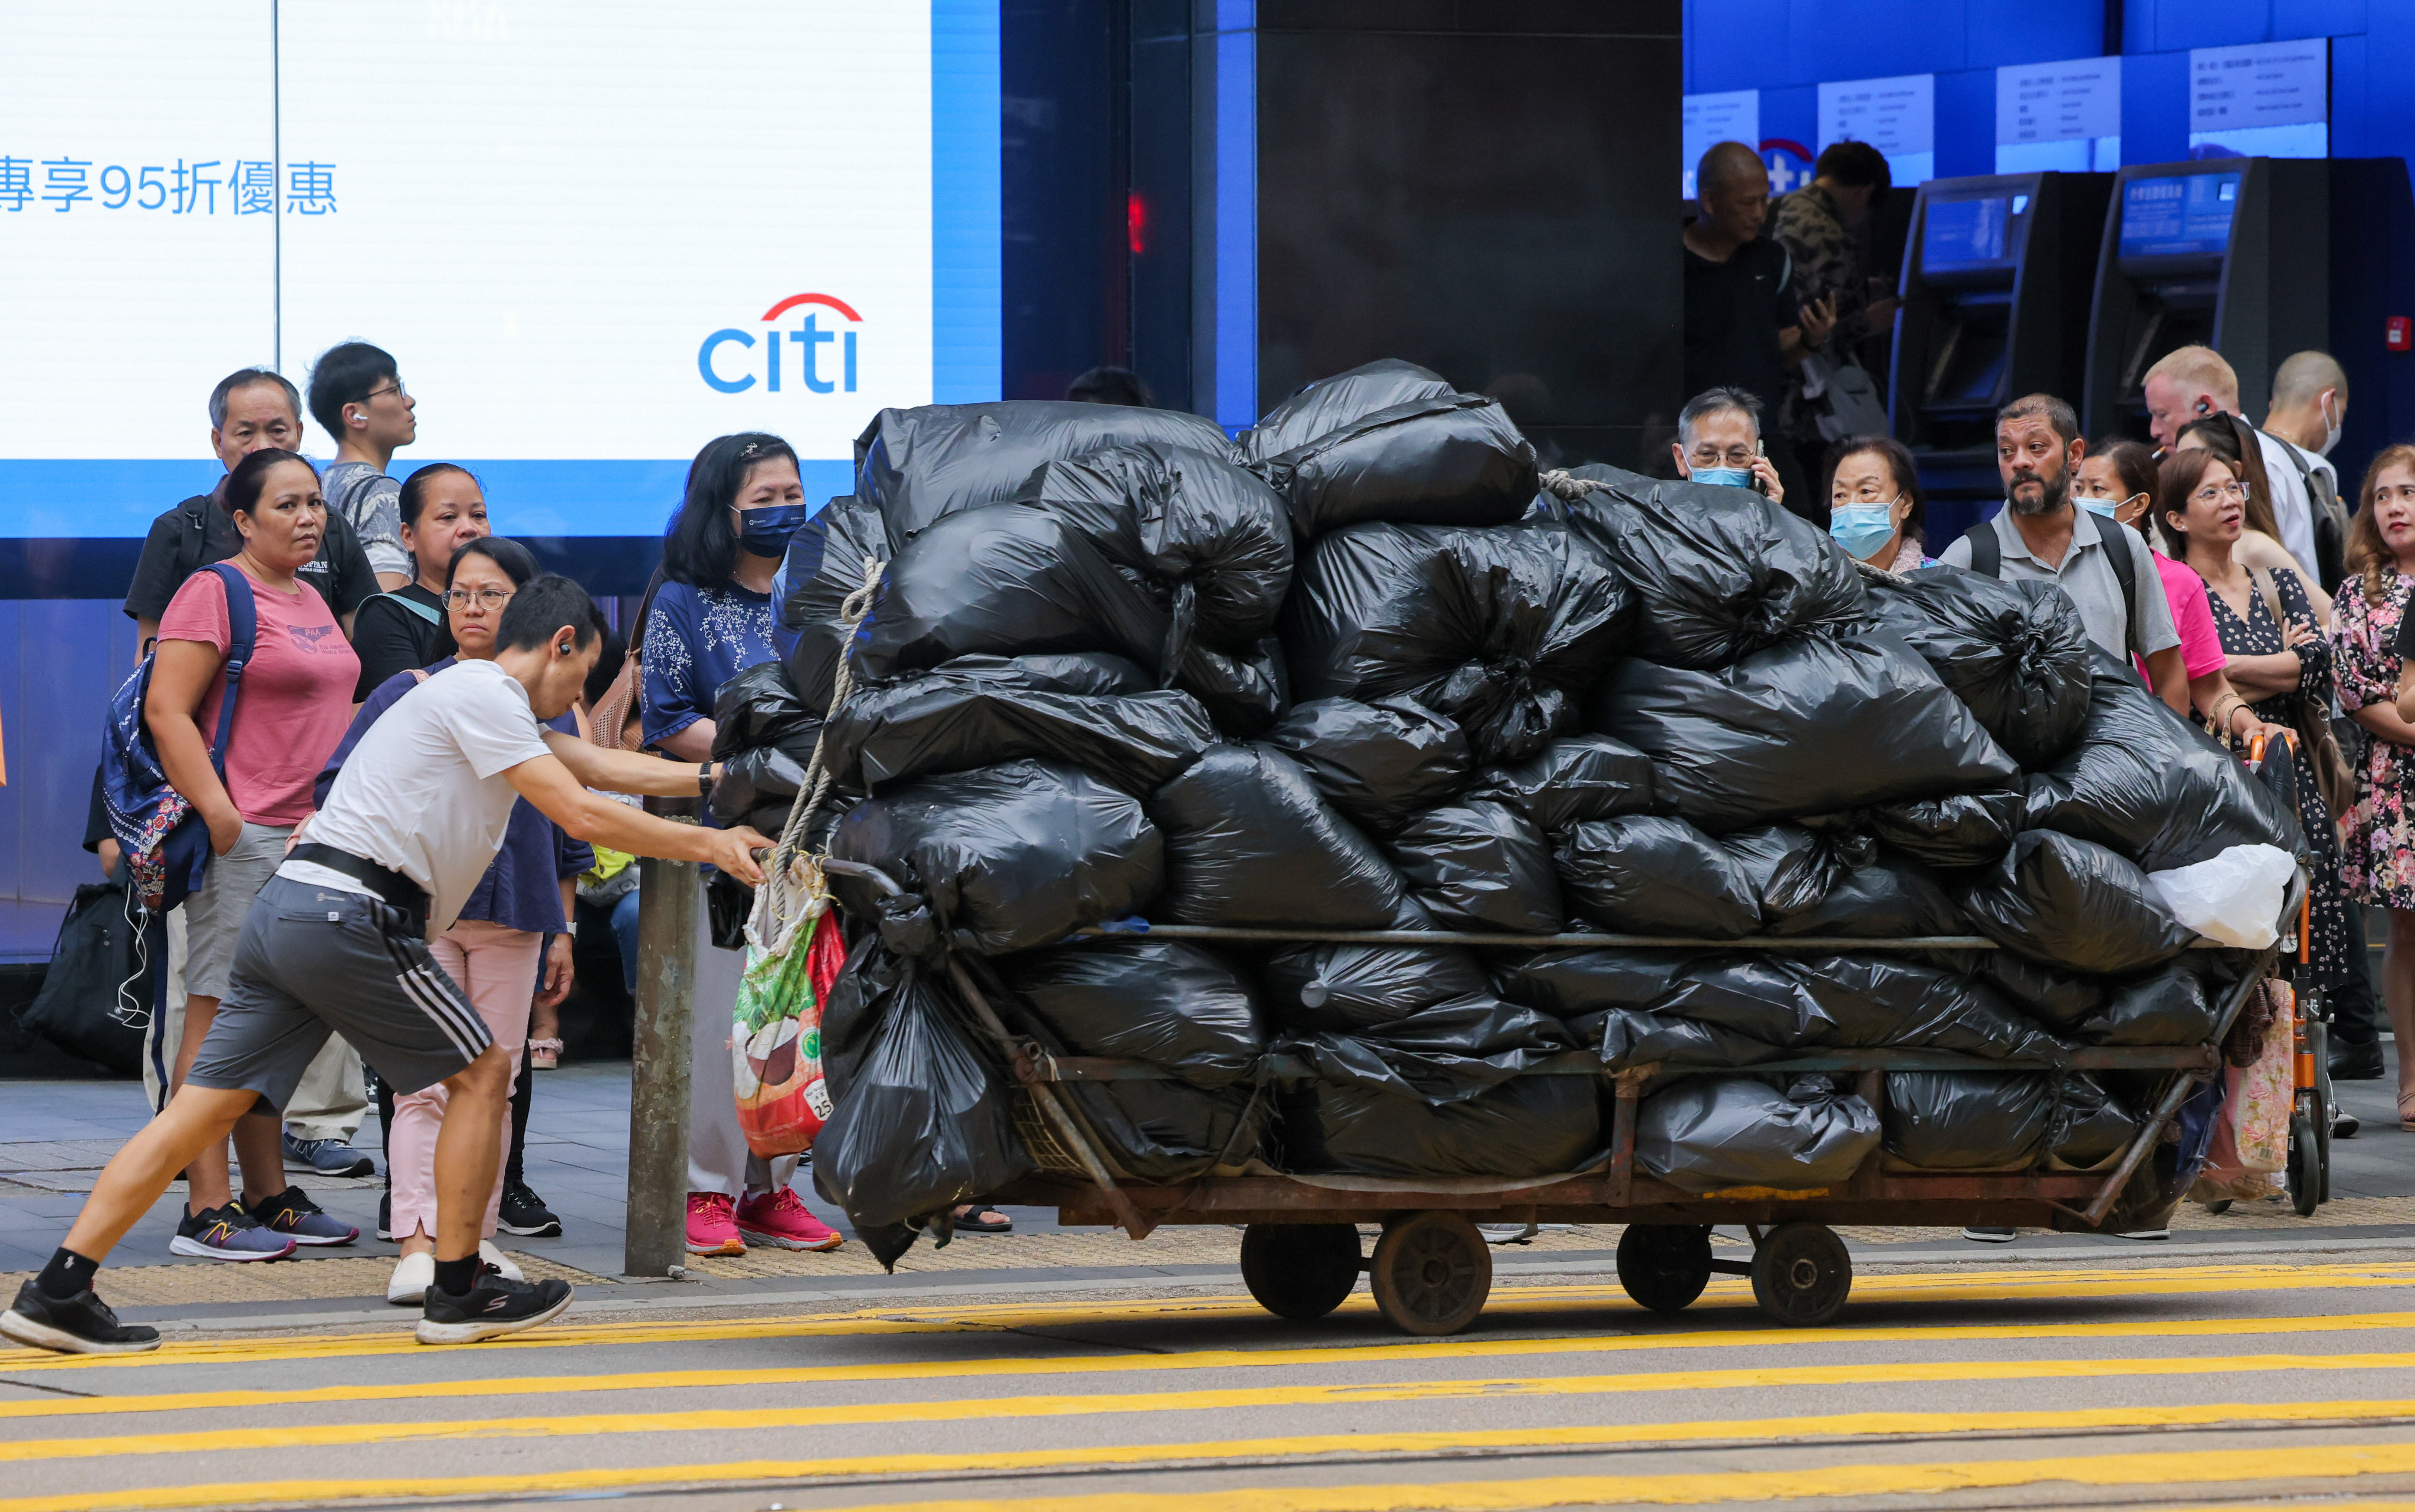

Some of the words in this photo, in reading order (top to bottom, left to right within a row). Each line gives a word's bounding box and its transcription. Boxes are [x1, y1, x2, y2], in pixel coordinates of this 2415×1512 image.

[0, 155, 337, 215] 專享95折優惠
[698, 311, 857, 394] citi
[814, 1100, 832, 1118] 25
